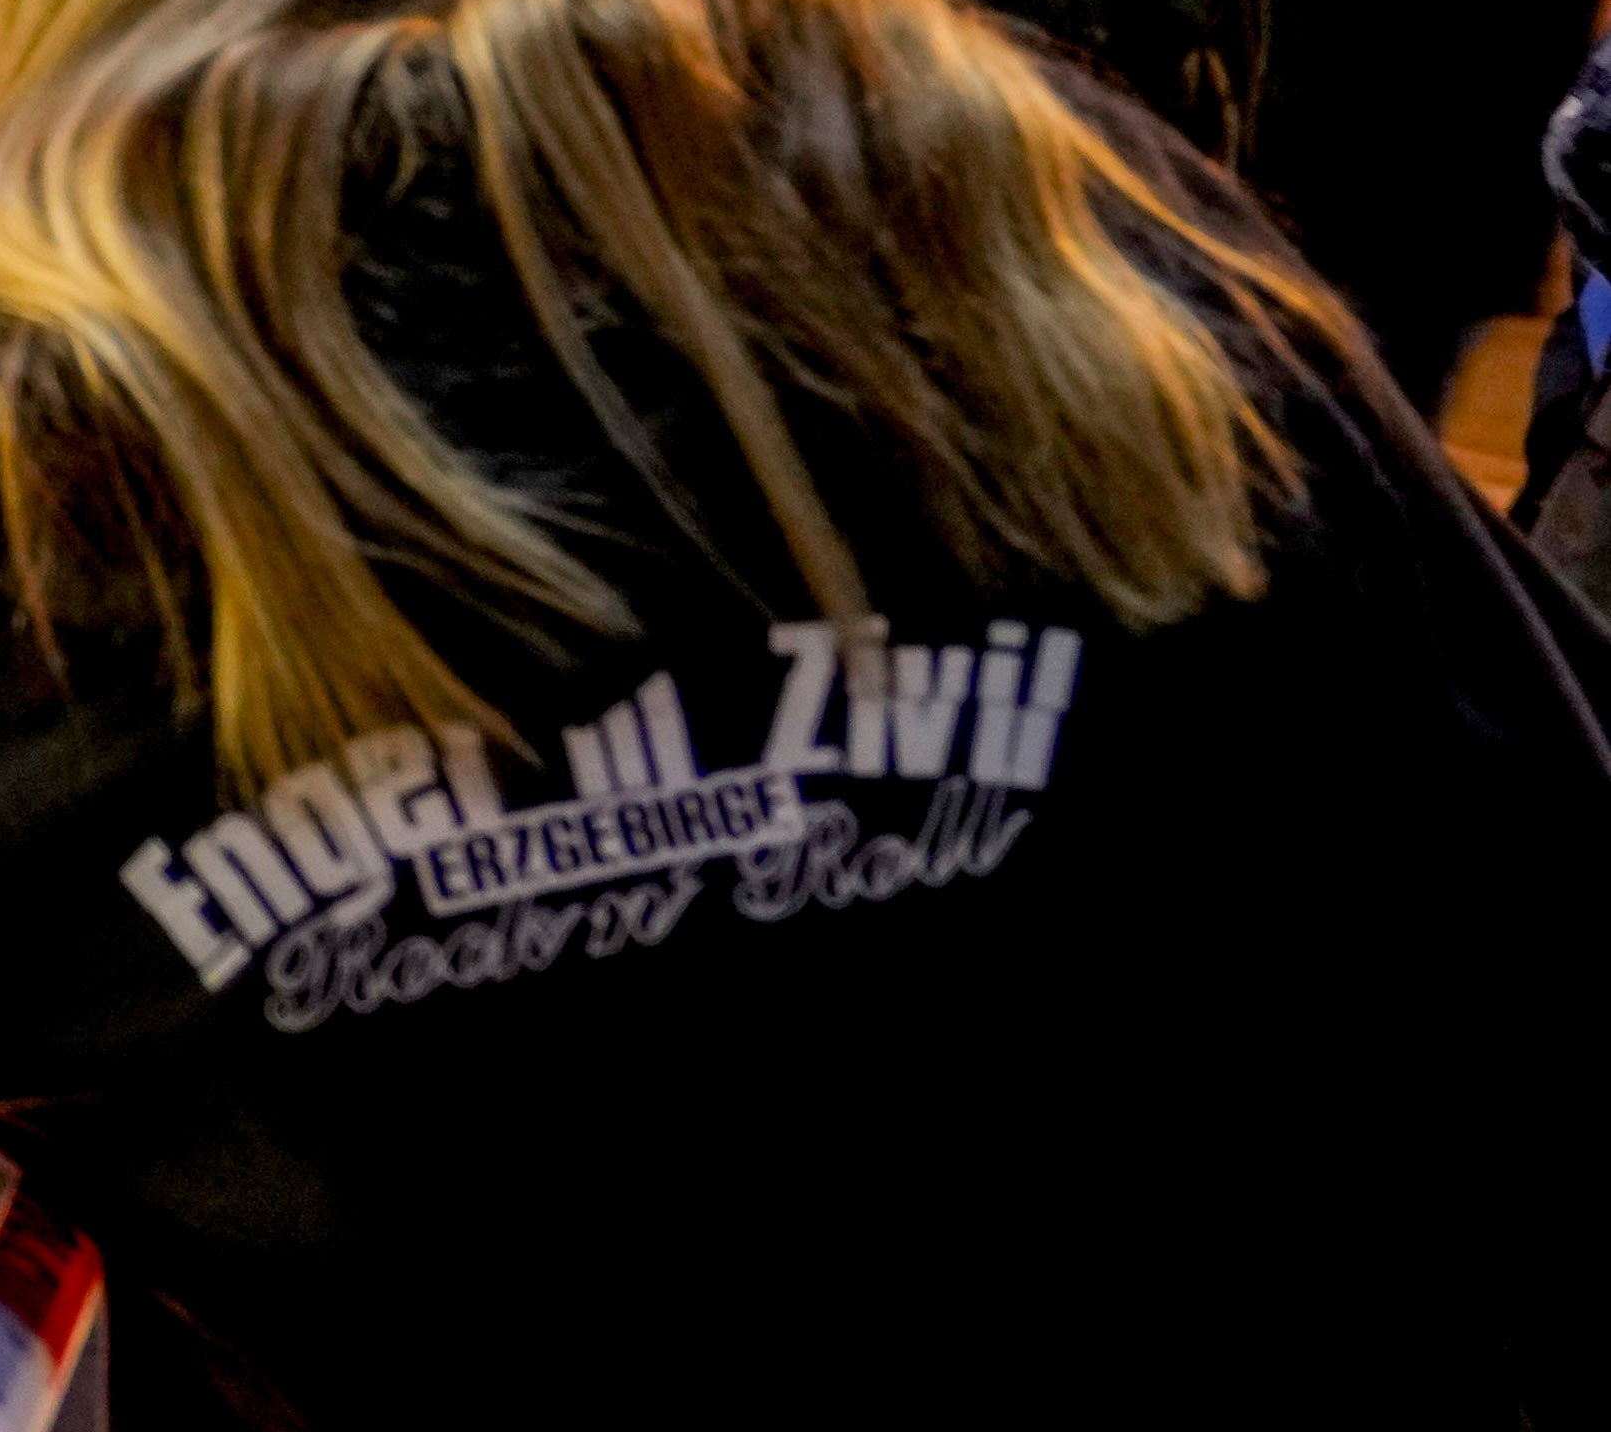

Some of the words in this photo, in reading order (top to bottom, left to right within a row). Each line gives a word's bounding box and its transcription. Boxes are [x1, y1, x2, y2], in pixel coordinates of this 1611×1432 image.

[117, 720, 505, 994] Engel
[759, 612, 1084, 792] Zivil
[263, 894, 587, 1034] Rock
[732, 772, 1035, 923] Roll
[429, 772, 791, 902] ERZGEBIRGE
